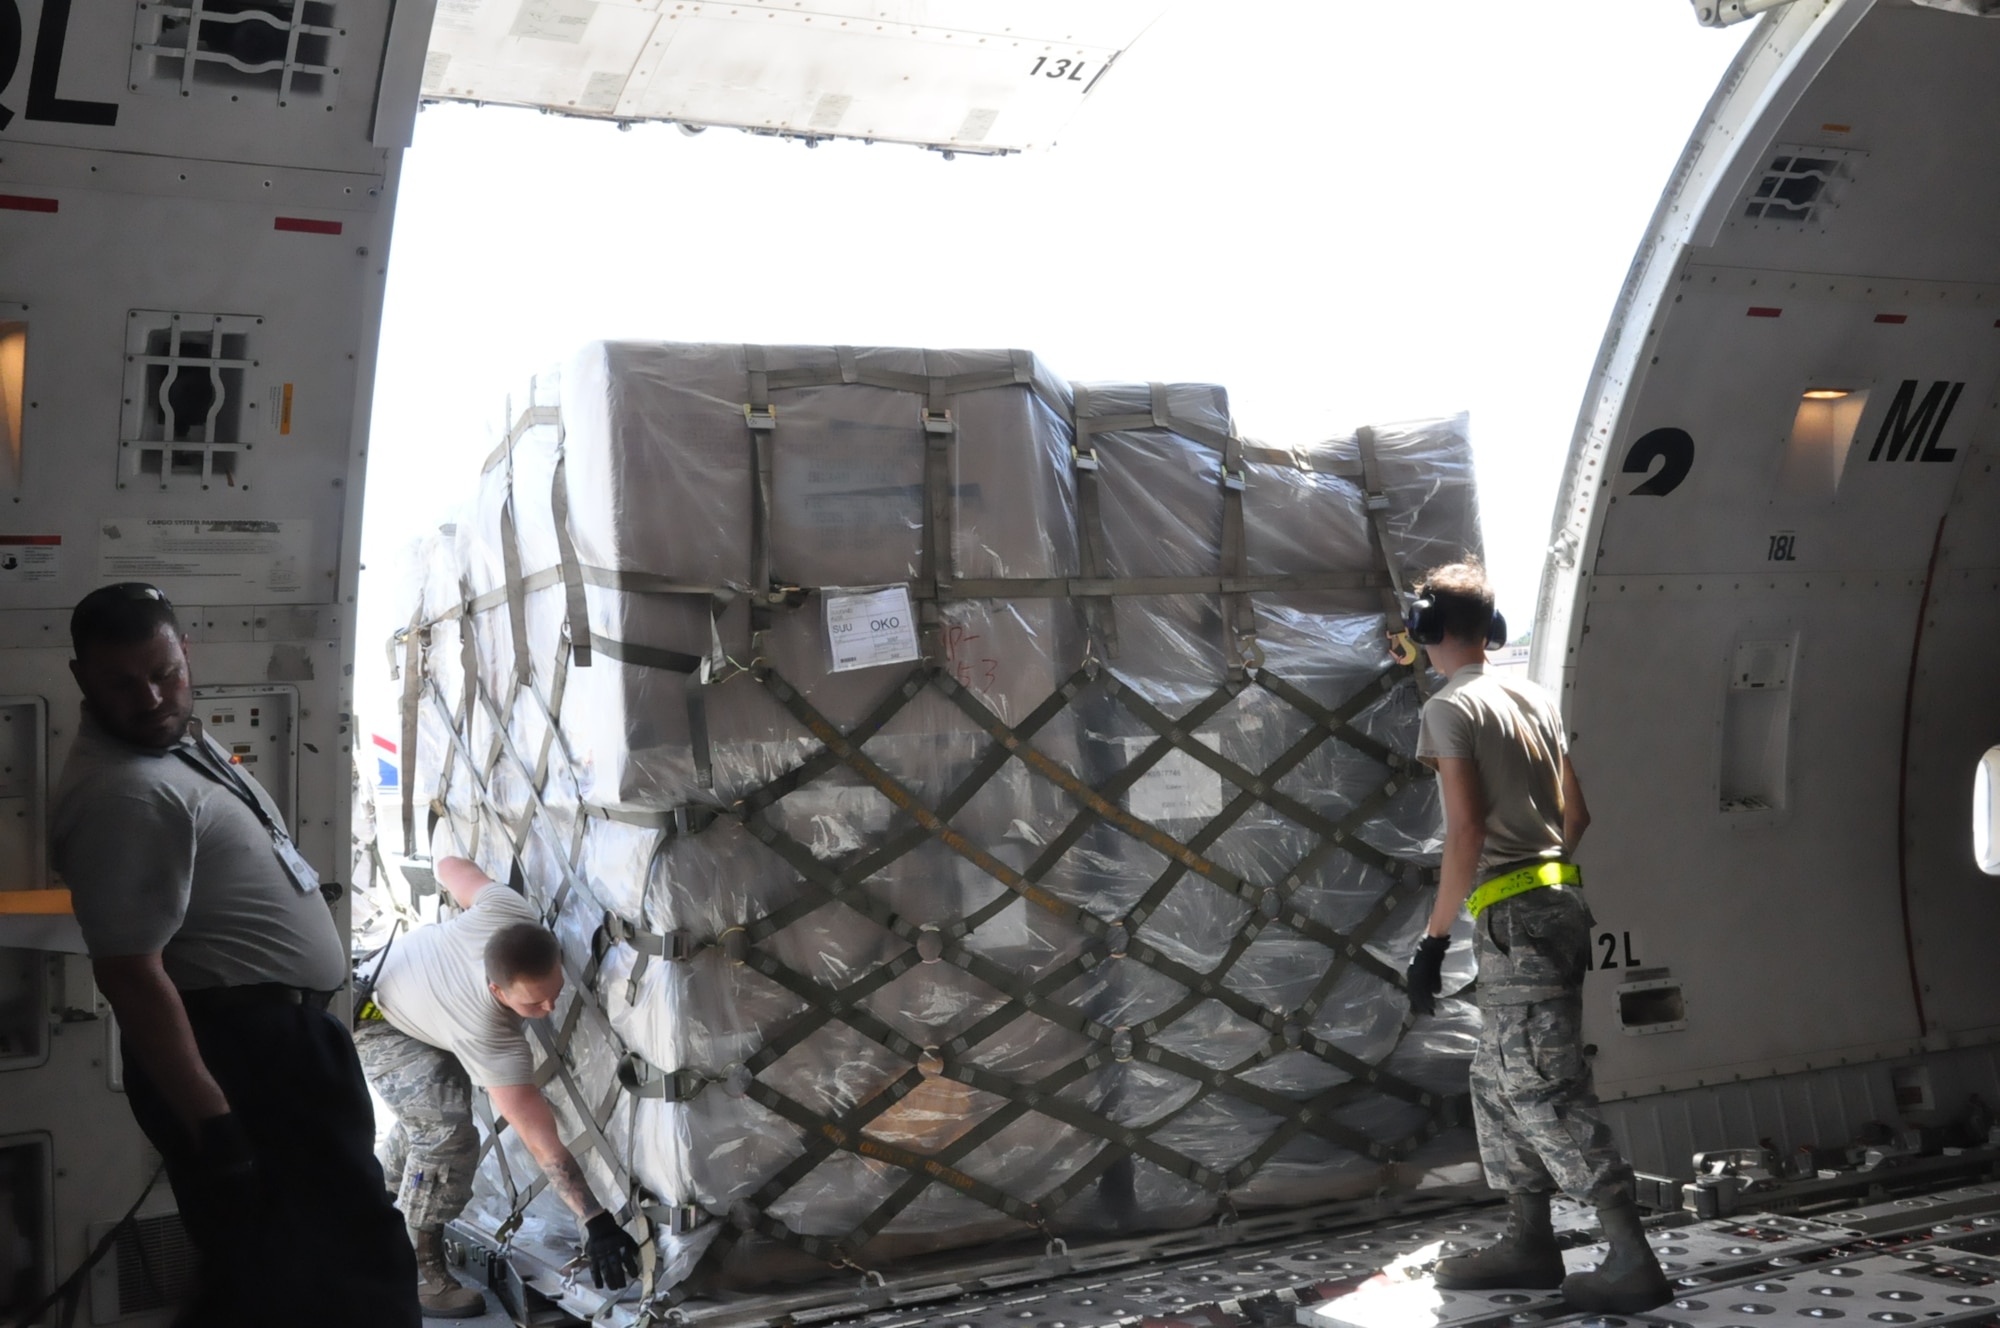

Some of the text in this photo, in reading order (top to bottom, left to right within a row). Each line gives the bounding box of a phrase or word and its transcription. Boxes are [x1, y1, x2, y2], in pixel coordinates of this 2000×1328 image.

[1030, 56, 1086, 81] 13L
[1868, 380, 1966, 463] ML
[1623, 427, 1695, 497] 2
[1768, 535, 1796, 561] 18L
[832, 616, 900, 633] SUU OKO
